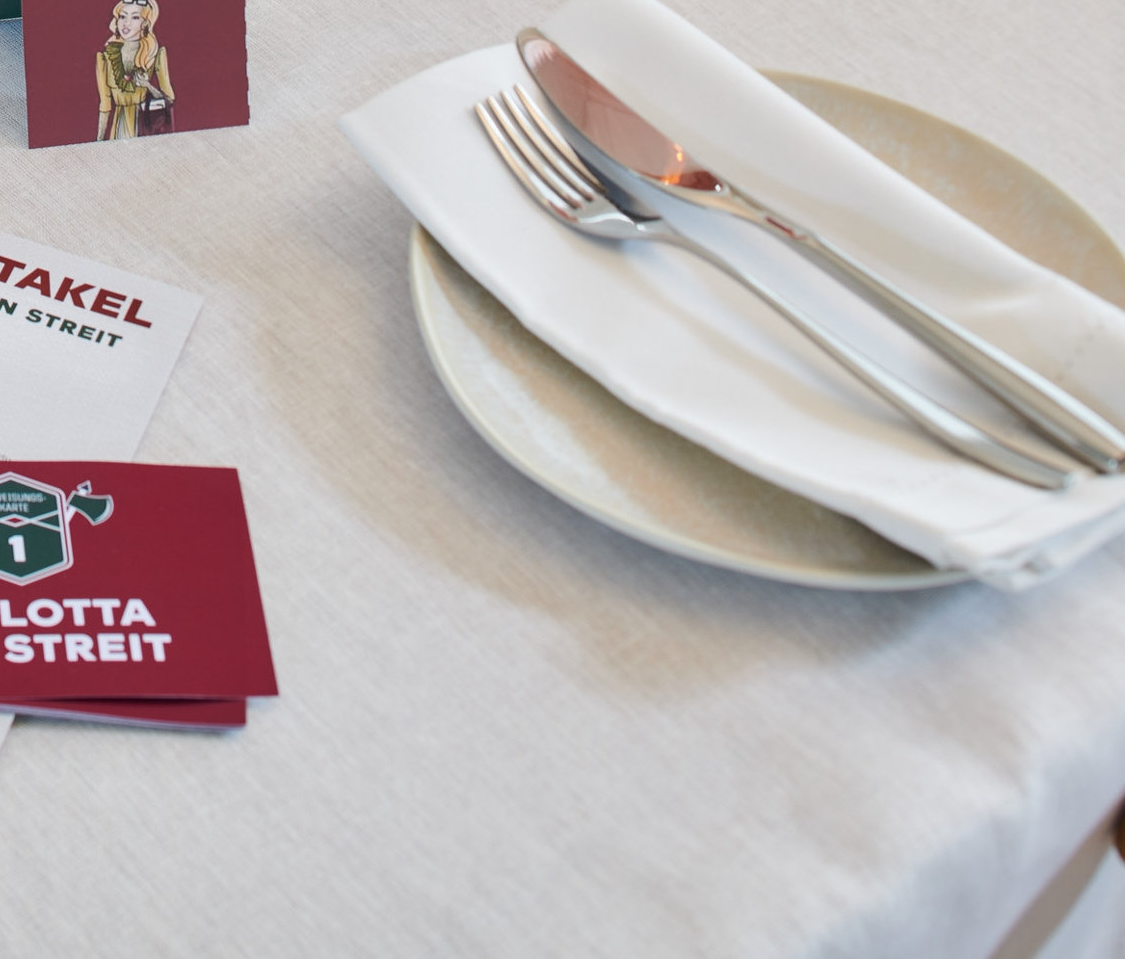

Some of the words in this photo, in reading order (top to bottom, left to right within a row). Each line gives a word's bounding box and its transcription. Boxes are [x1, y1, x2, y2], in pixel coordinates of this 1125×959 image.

[25, 309, 123, 348] STREIT
[0, 503, 29, 513] KARTE
[8, 534, 26, 562] 1
[4, 633, 172, 663] STREIT
